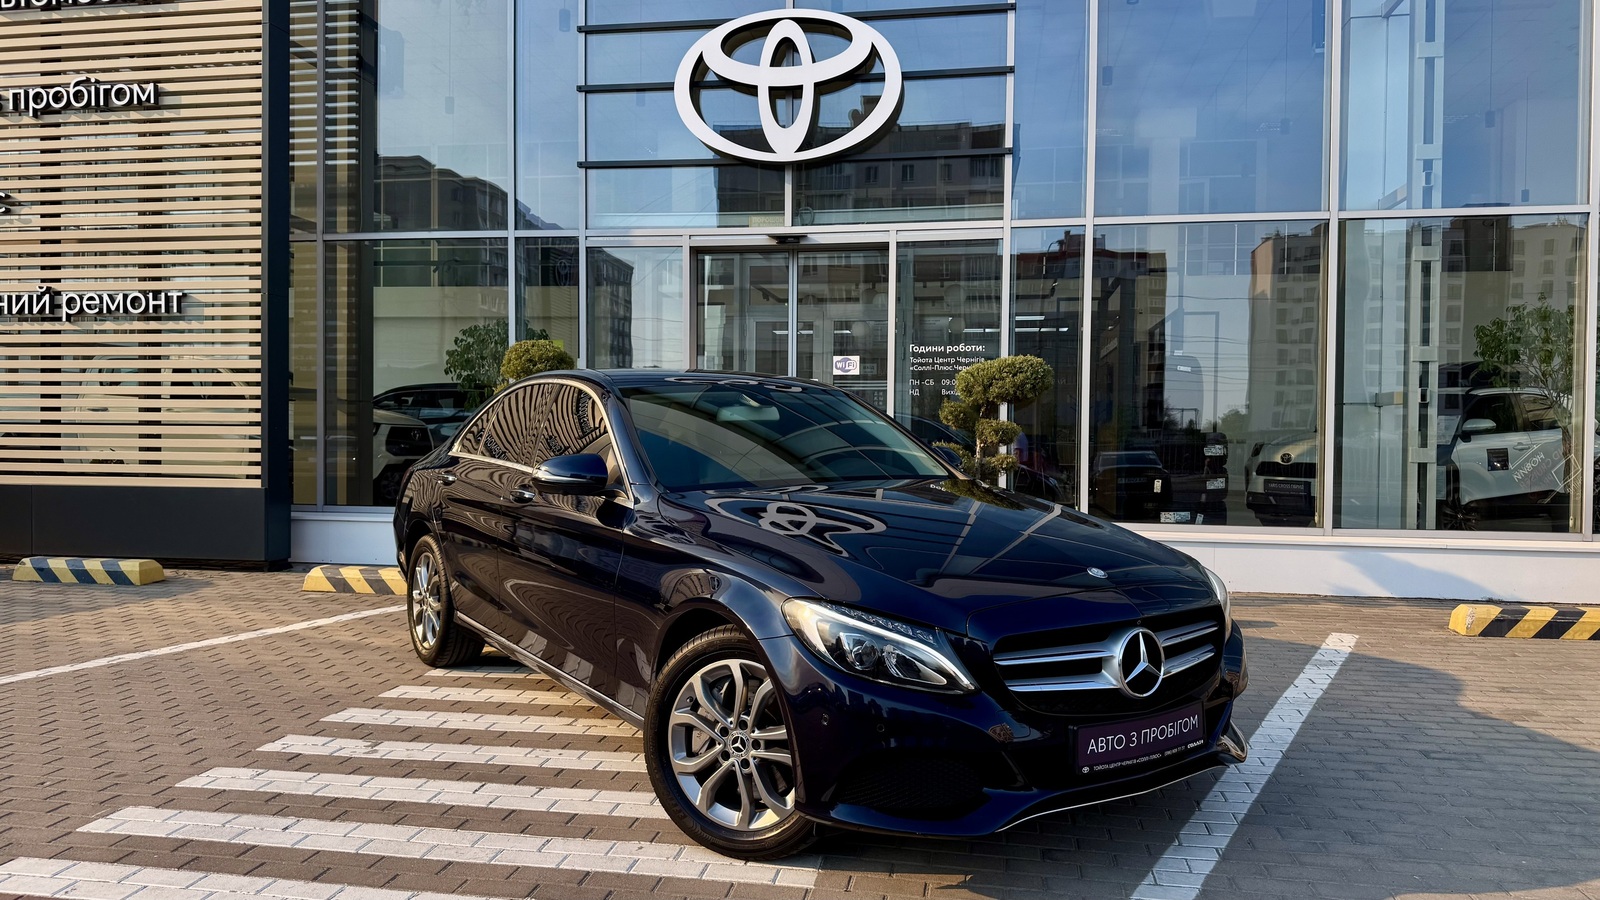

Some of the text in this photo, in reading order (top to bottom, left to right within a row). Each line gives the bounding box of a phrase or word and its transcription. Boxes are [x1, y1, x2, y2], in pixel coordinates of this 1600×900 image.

[9, 76, 156, 117] пробігом
[62, 292, 183, 322] ремонт
[909, 343, 986, 354] Години роботи:
[909, 356, 933, 364] Тойота
[933, 356, 956, 364] Центр
[909, 388, 920, 396] НД
[1087, 734, 1126, 755] АВТО
[1141, 714, 1199, 745] ПРОБІГОМ
